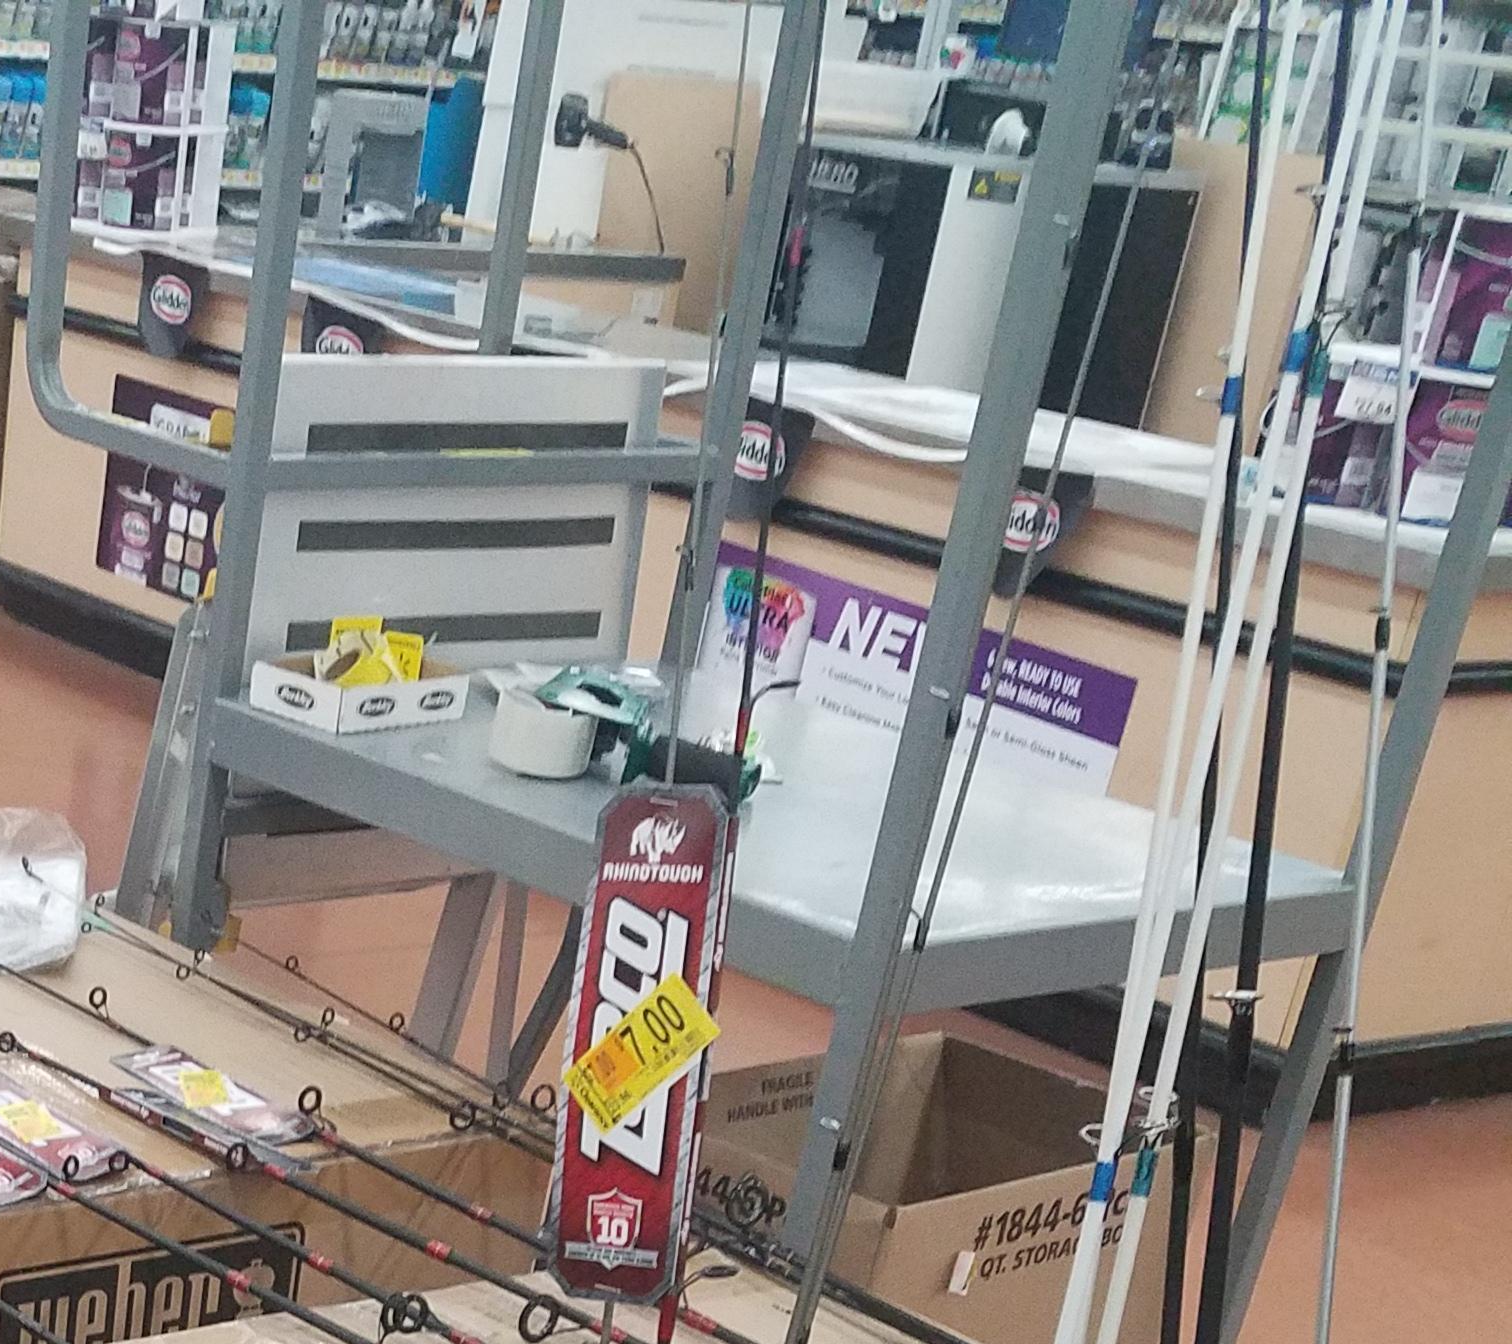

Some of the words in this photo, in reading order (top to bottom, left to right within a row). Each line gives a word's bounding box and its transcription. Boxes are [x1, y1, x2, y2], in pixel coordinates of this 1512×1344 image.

[580, 896, 689, 1177] ZCO
[596, 1215, 629, 1247] 10
[1012, 1237, 1081, 1272] STORA
